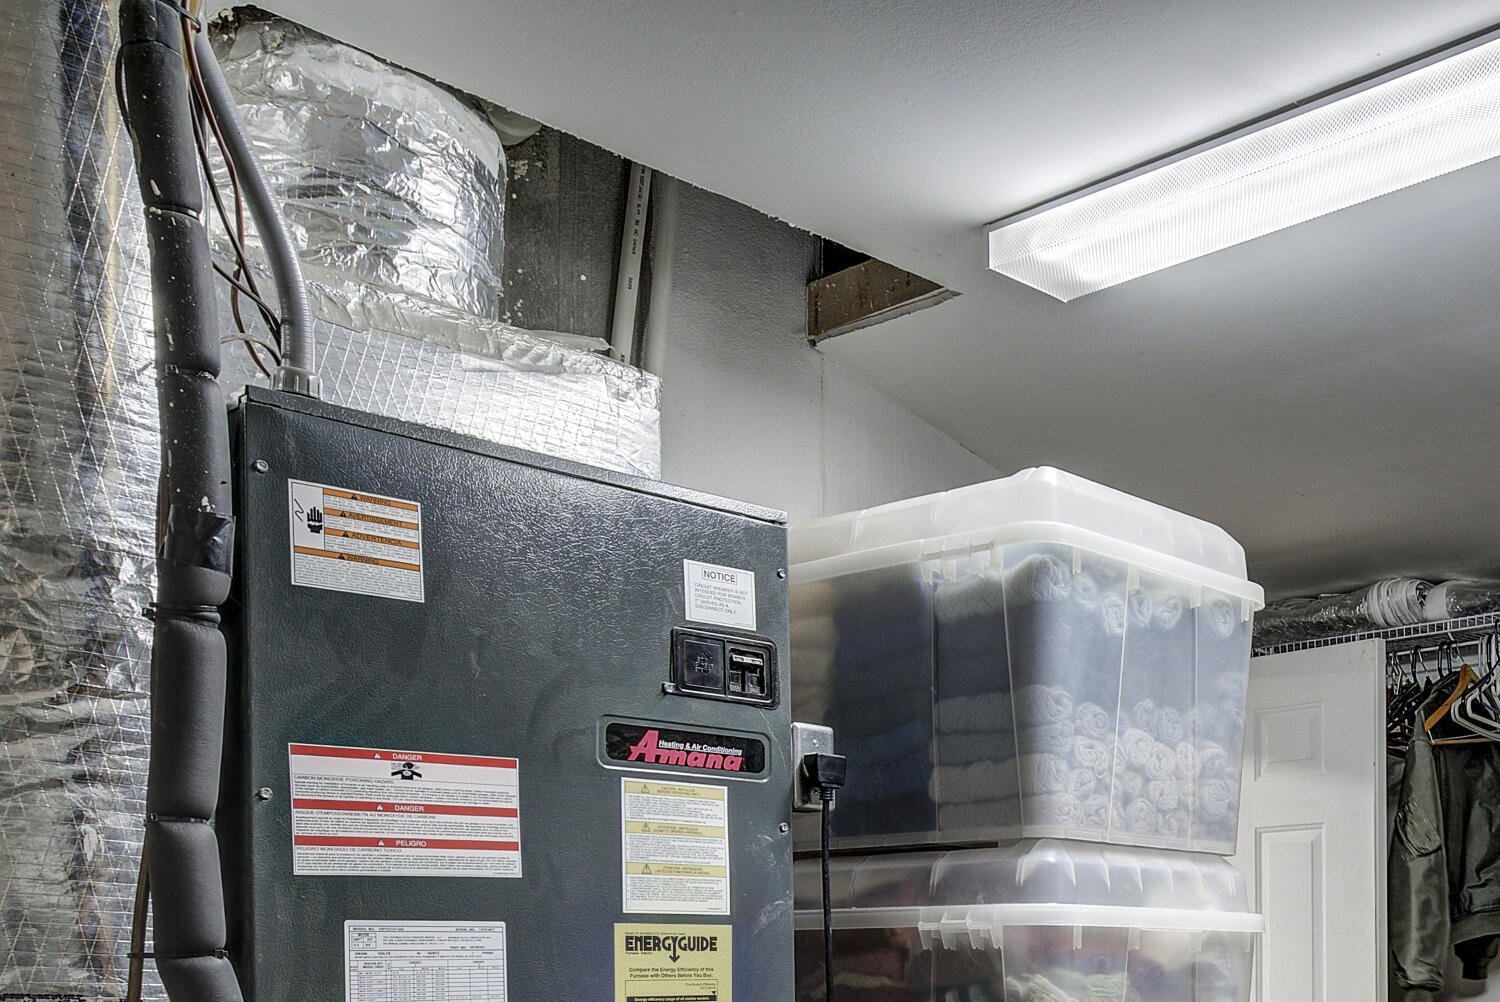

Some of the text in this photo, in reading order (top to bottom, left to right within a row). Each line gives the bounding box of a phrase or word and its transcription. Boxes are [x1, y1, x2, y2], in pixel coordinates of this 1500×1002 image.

[703, 569, 736, 583] NOTICE
[627, 729, 745, 772] Amana
[658, 739, 685, 750] Heating
[692, 742, 702, 751] Air
[703, 744, 743, 757] Conditioning
[392, 753, 423, 761] DANGER
[394, 804, 424, 812] DANGER
[395, 839, 427, 848] PELIGRO
[625, 935, 718, 952] ENERGYGUIDE
